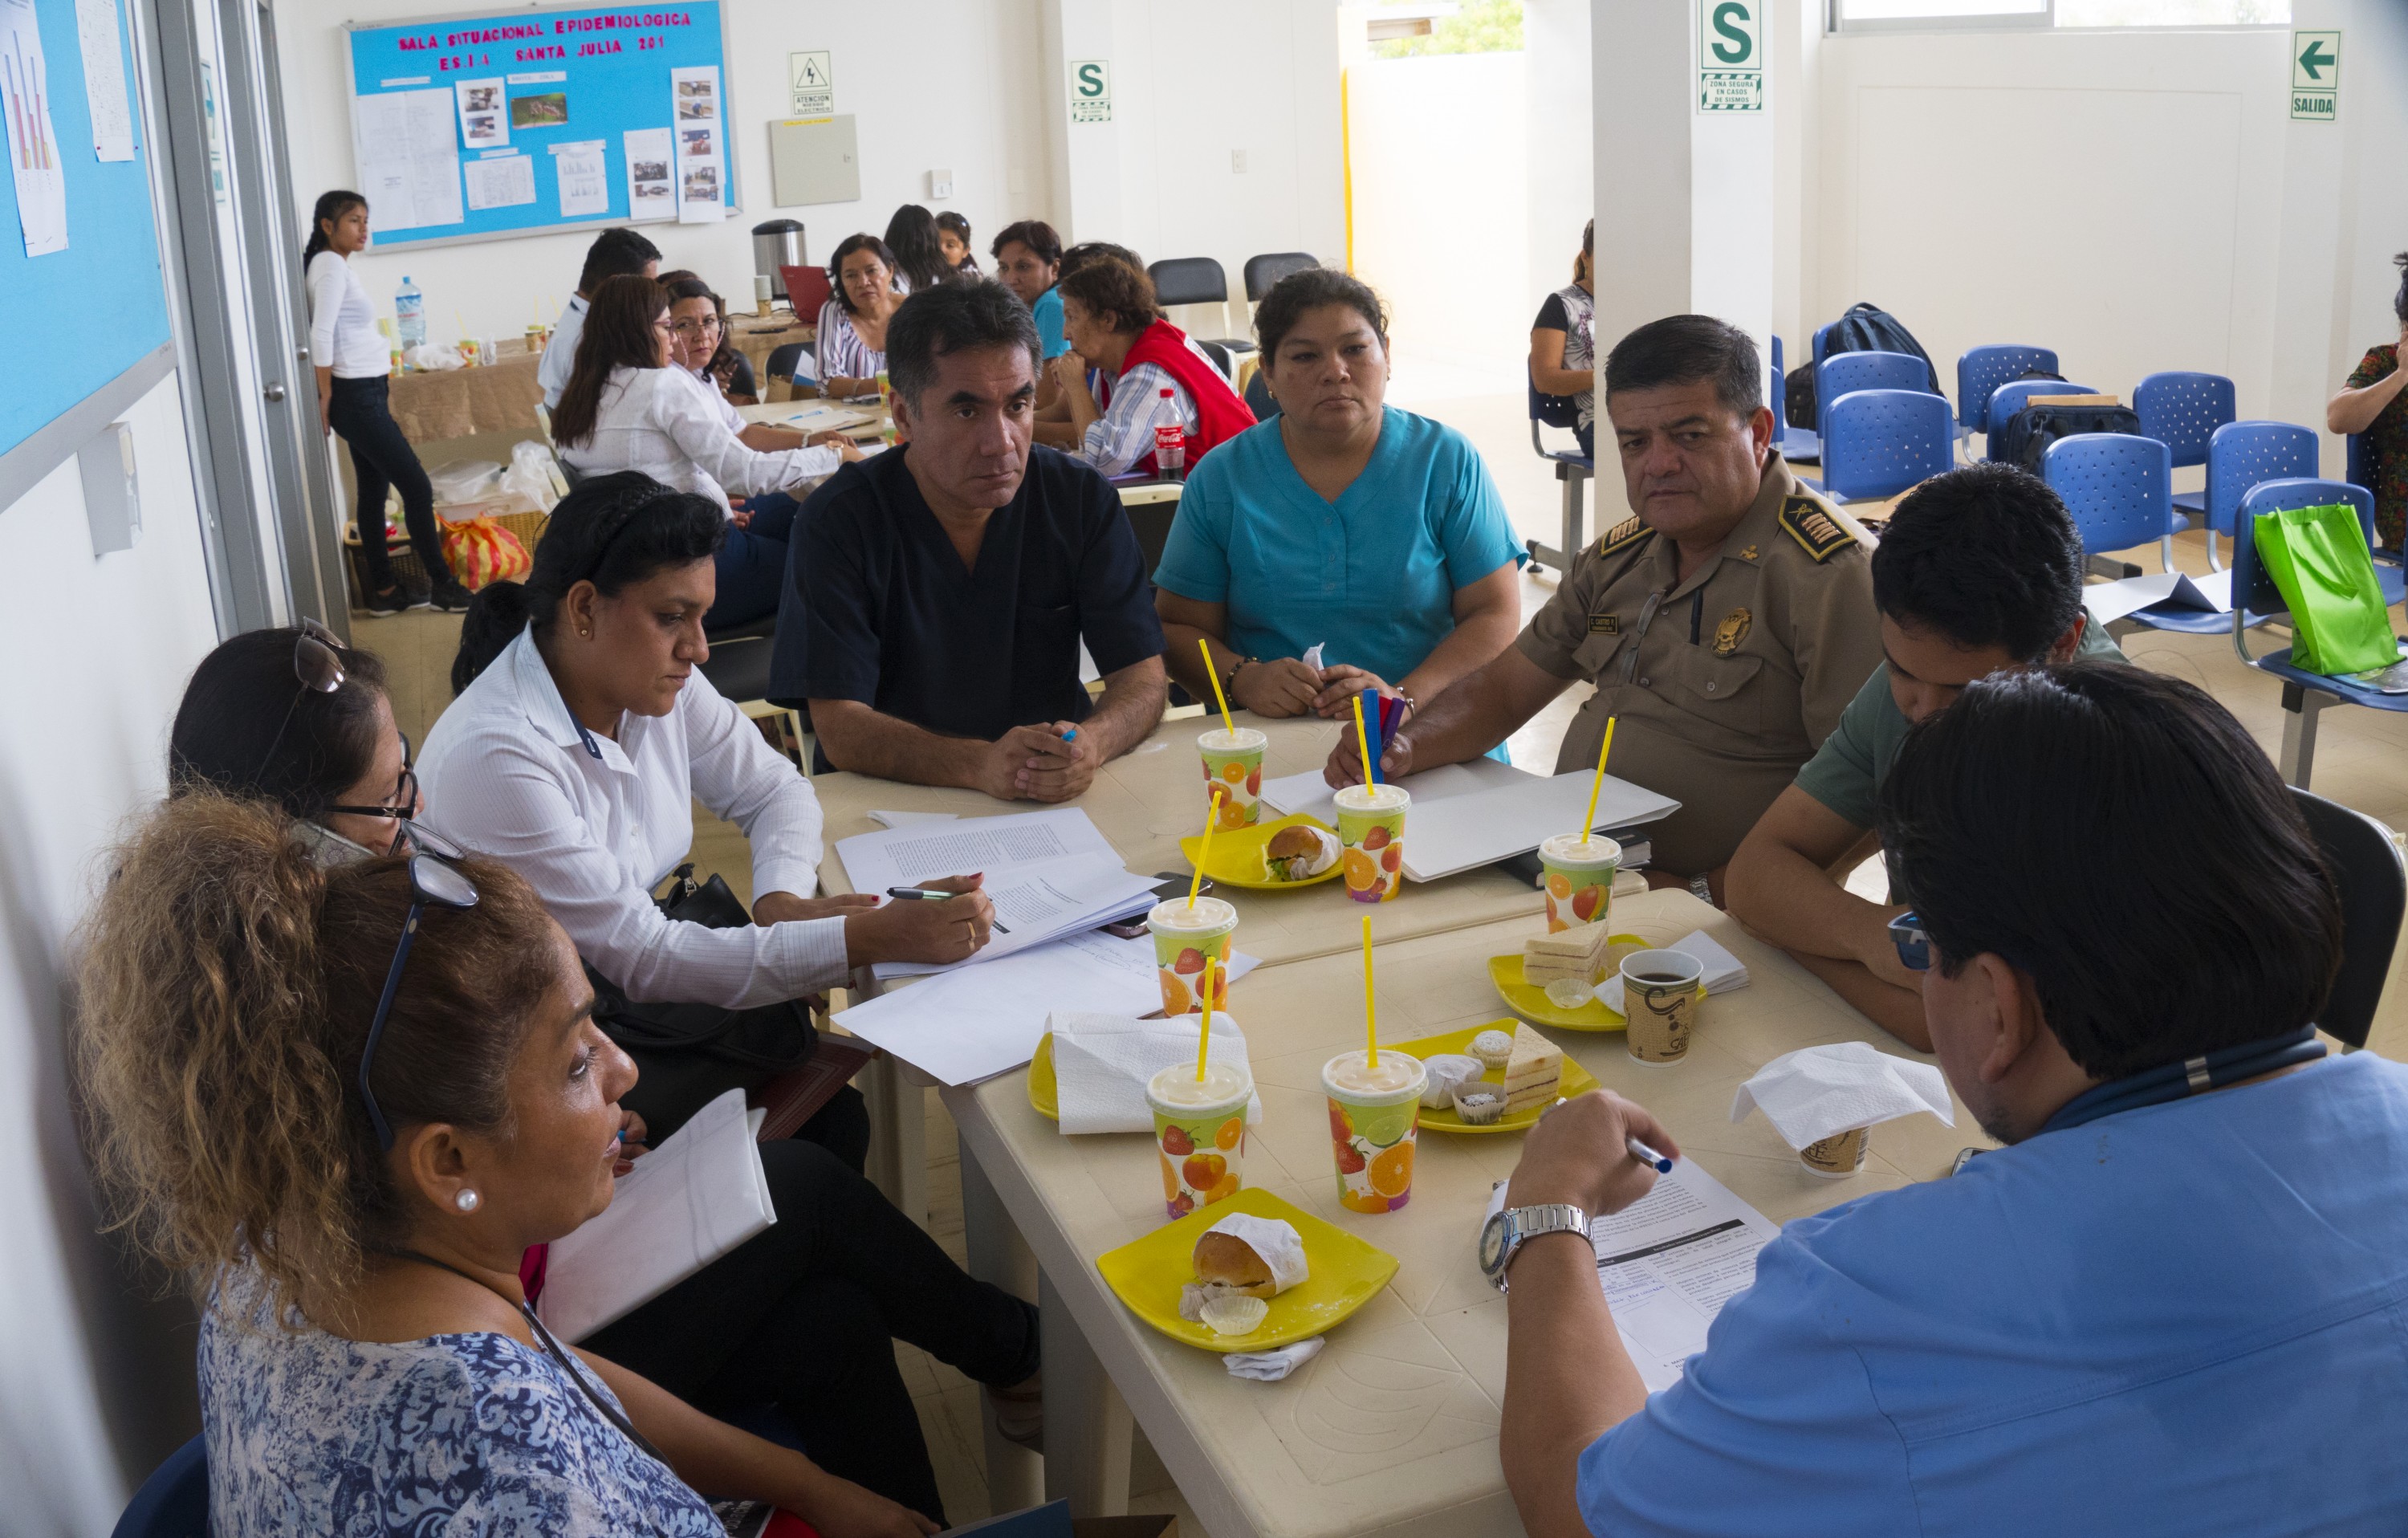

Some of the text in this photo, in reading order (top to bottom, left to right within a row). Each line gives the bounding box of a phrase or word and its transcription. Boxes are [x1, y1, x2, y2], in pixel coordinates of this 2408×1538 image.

[399, 13, 690, 51] SALA SITUACIONAL EPIDEMIOLOGICA
[1711, 2, 1752, 63] S
[515, 45, 566, 62] SANTA
[577, 39, 622, 57] JULIA
[638, 35, 664, 51] 201
[1078, 63, 1104, 97] S
[2294, 98, 2333, 113] SALIDA
[1158, 433, 1181, 442] Coca-Cola
[1670, 1031, 1690, 1050] CAF
